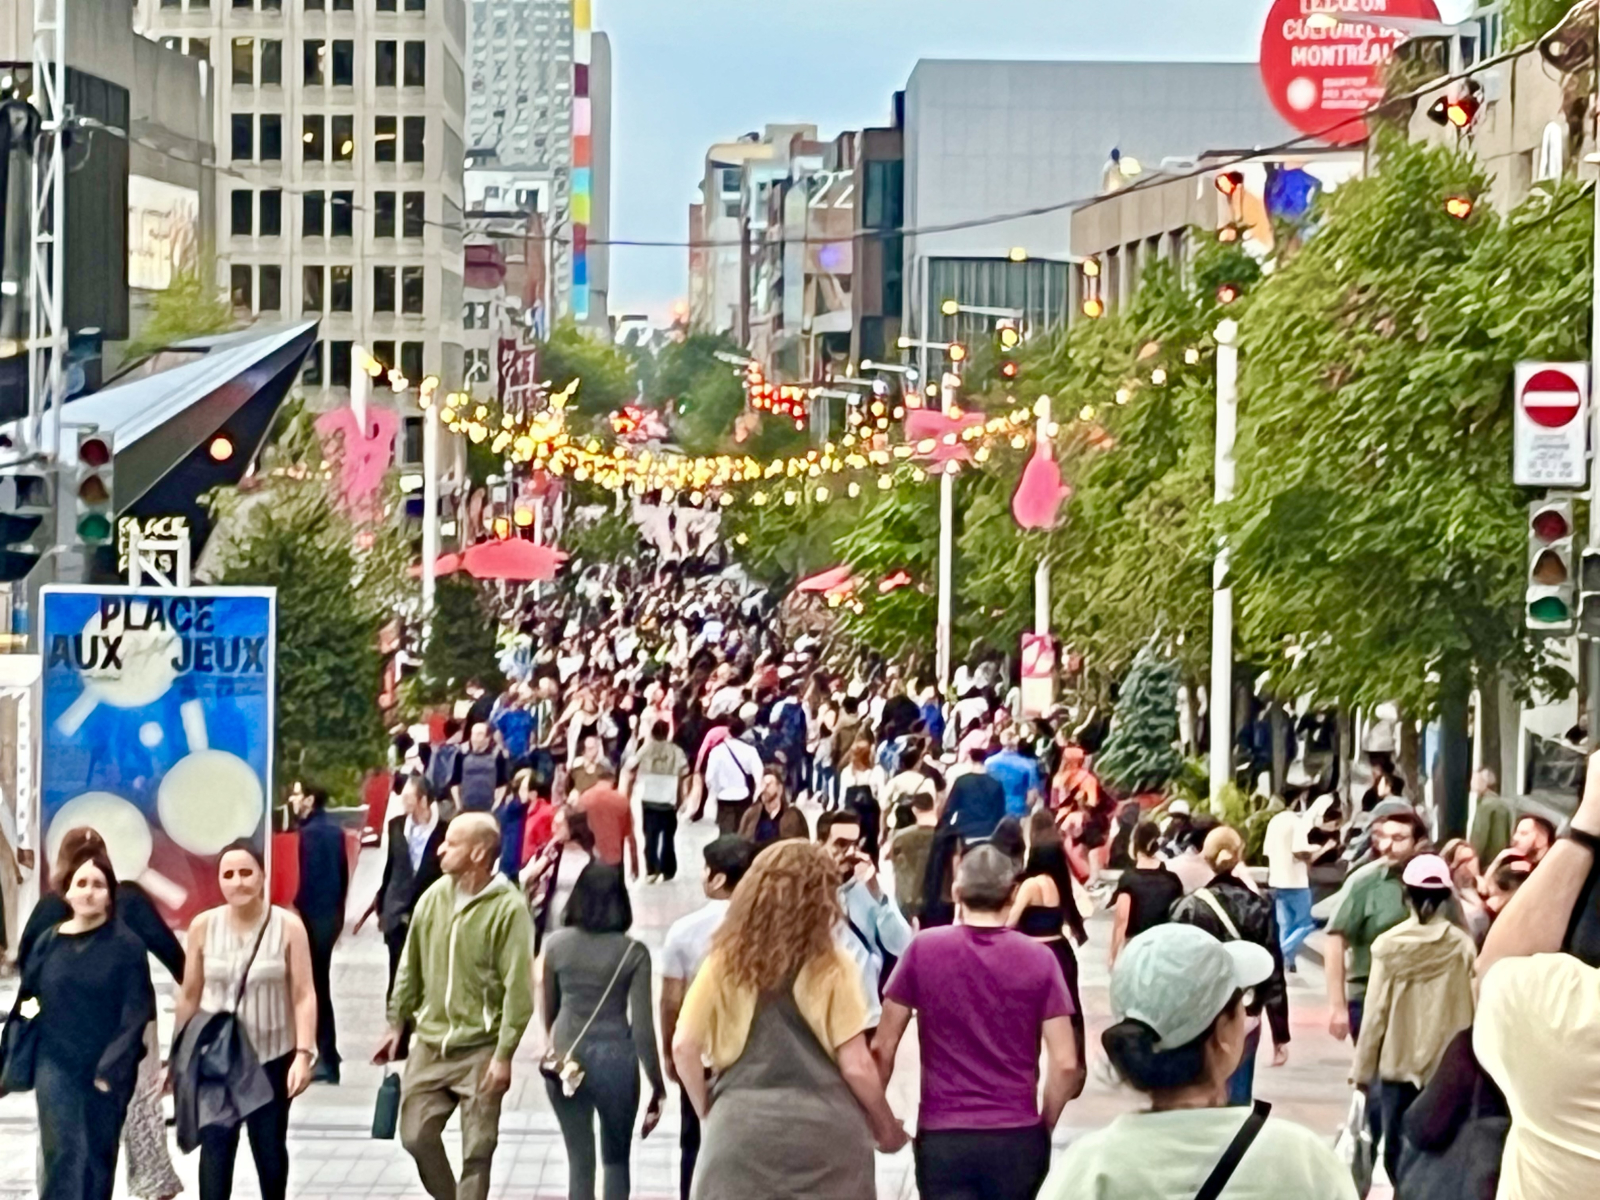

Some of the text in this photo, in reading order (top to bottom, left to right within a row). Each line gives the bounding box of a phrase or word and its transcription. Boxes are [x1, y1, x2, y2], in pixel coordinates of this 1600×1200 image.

[100, 596, 214, 632] PLACE
[49, 634, 264, 673] AUX JEUX
